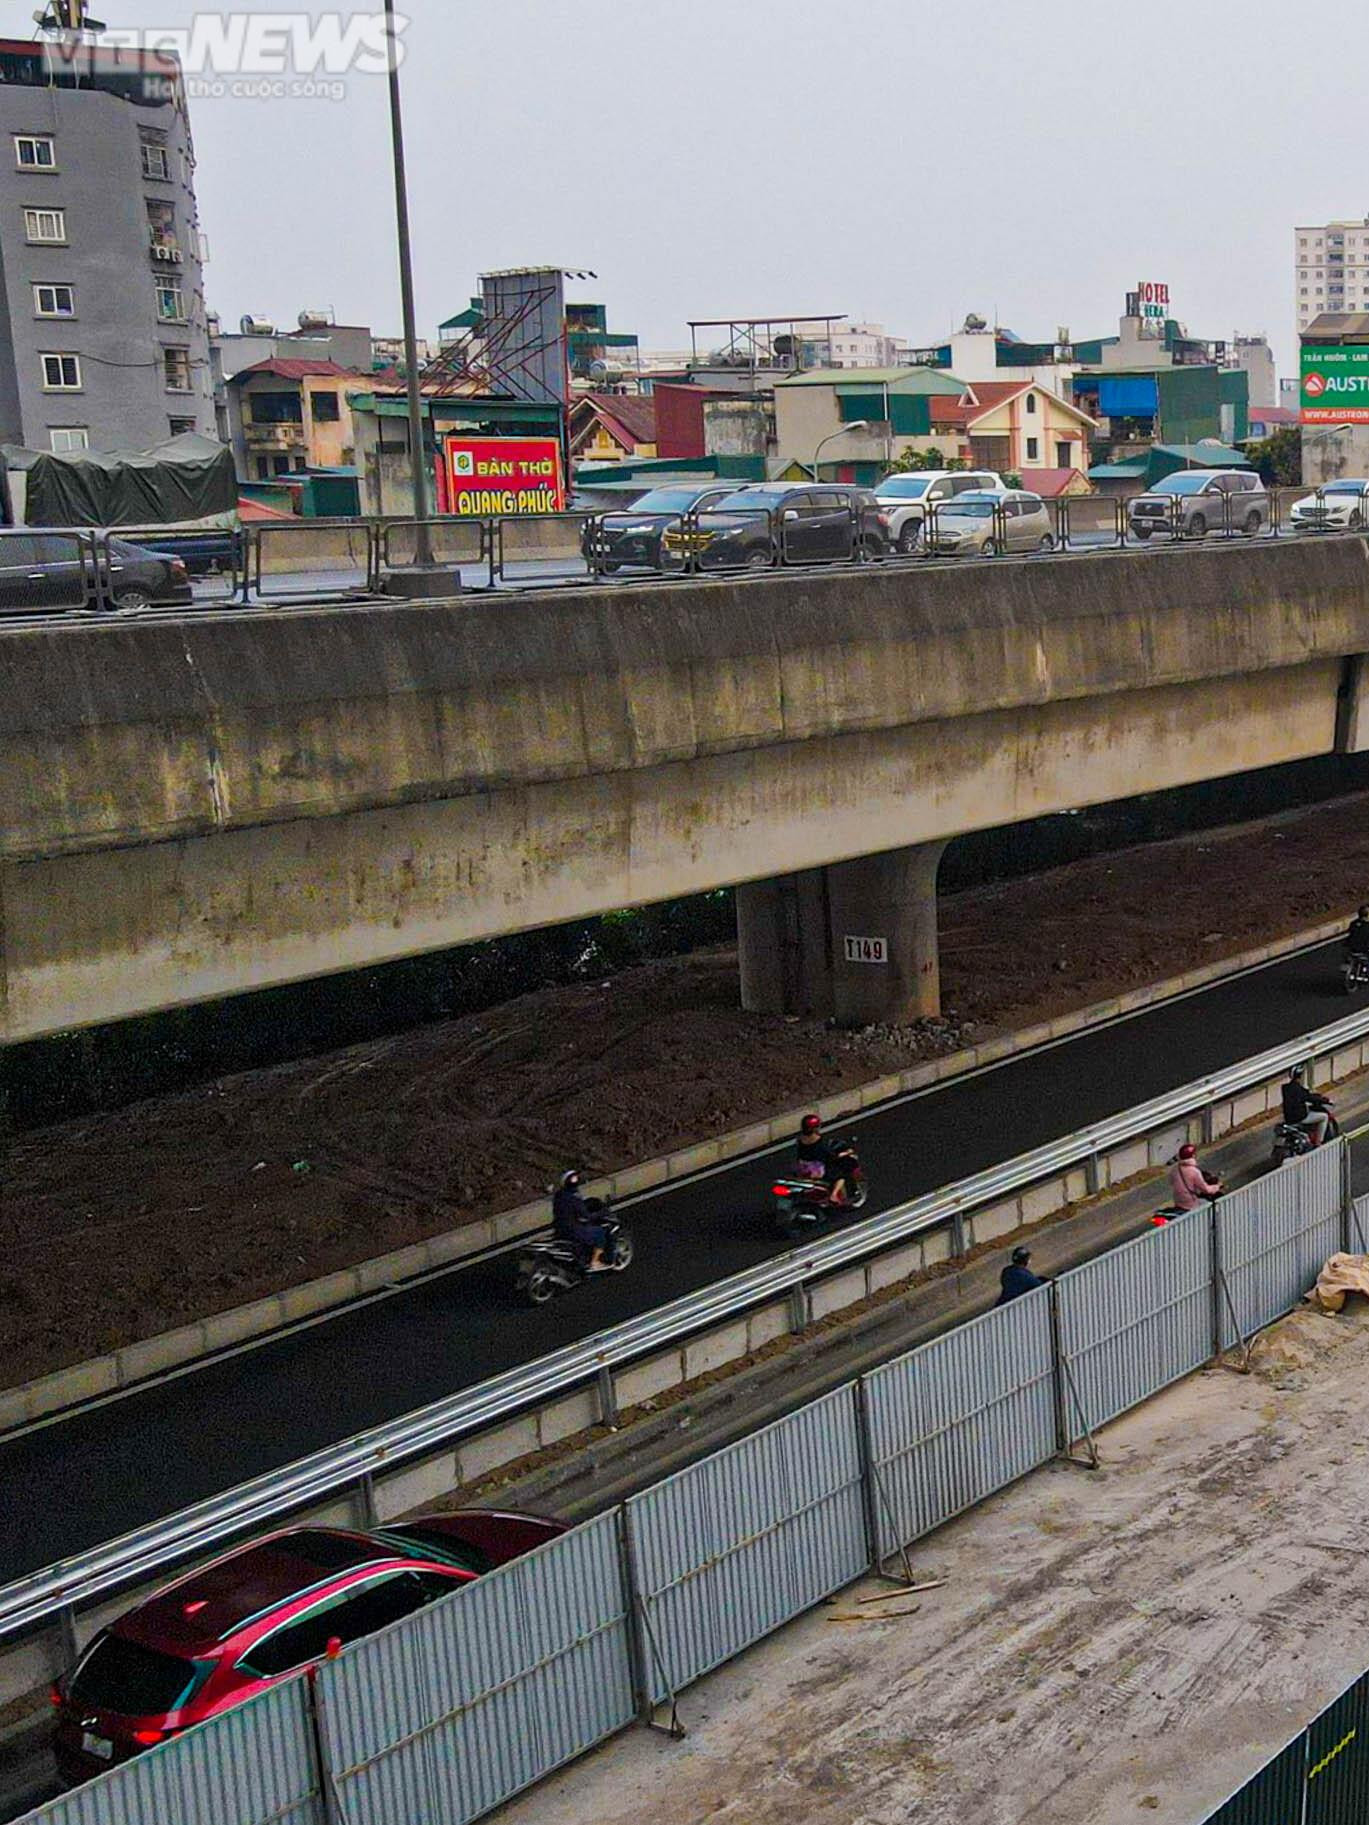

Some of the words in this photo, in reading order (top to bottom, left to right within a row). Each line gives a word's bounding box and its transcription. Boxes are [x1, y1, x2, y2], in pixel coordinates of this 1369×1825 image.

[1138, 281, 1170, 304] HOTEL
[477, 457, 513, 475] BÀN
[519, 456, 554, 475] THỜ
[458, 489, 515, 514] QUANG
